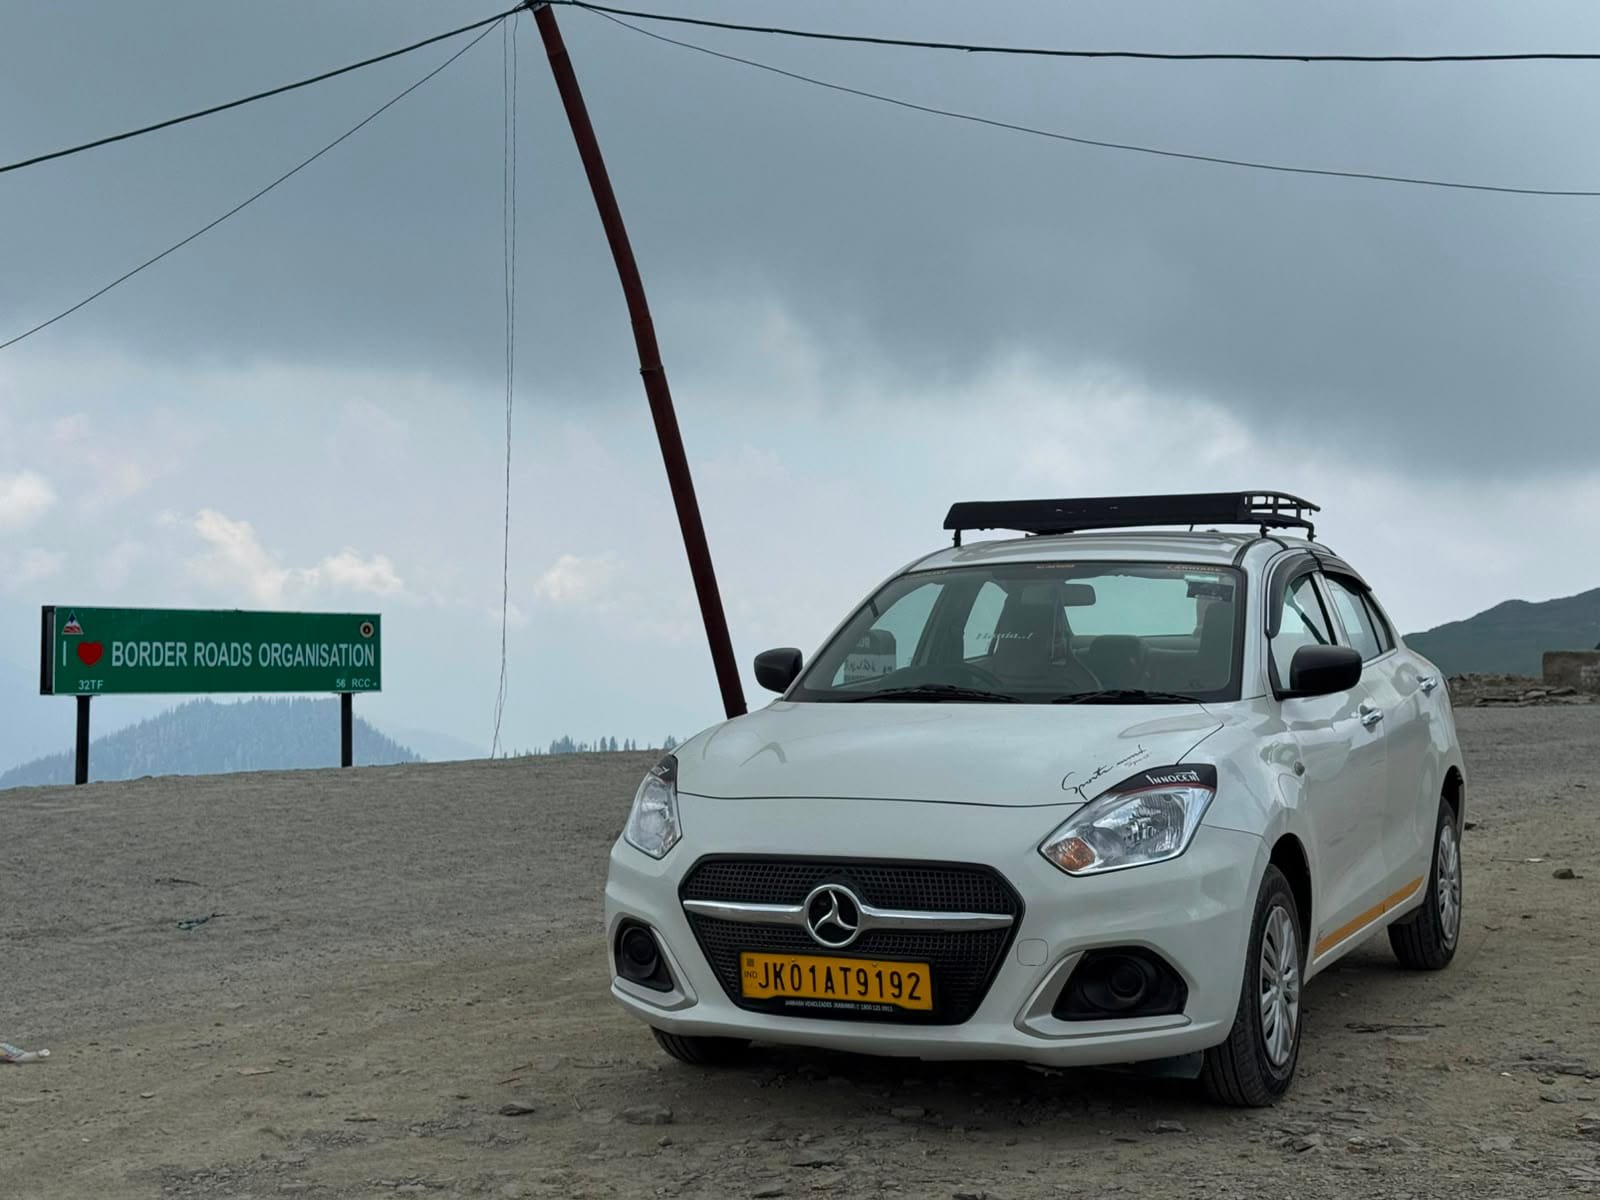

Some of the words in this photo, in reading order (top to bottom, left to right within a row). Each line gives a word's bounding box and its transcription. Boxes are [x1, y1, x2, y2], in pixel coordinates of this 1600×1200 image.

[62, 640, 67, 667] I
[111, 641, 187, 668] BORDER
[193, 642, 253, 668] ROADS
[258, 643, 375, 668] ORGANISATION
[78, 679, 104, 691] 32TF
[352, 678, 371, 689] RCC
[758, 962, 921, 1000] JK01AT9192
